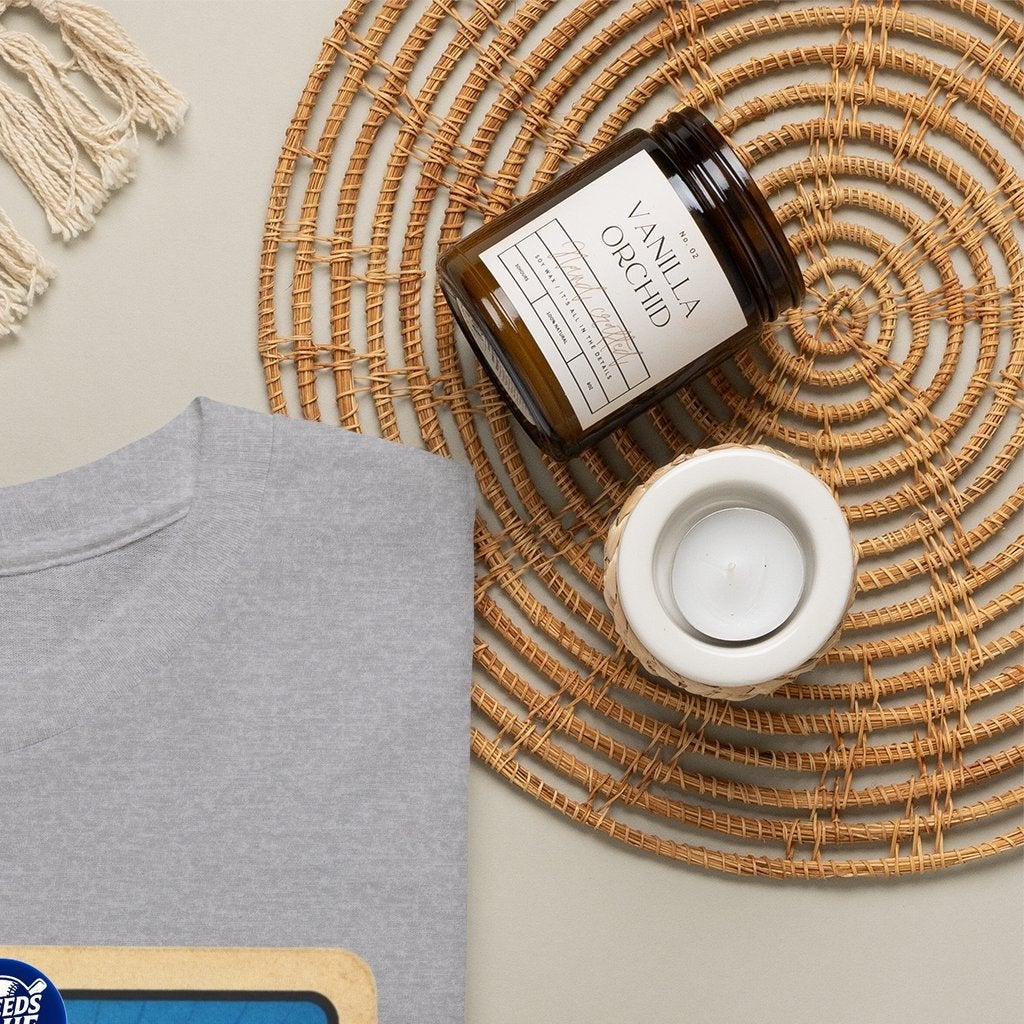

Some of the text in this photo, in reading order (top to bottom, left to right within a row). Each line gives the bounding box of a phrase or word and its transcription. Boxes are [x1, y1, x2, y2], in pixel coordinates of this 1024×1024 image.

[601, 225, 671, 327] ORCHID
[628, 200, 701, 318] VANILLA
[689, 248, 699, 259] 02
[535, 254, 545, 267] SOY
[545, 269, 555, 282] WAX
[570, 309, 579, 322] ALL
[579, 324, 586, 333] IN
[586, 335, 596, 349] THE
[594, 351, 612, 380] DETAILS
